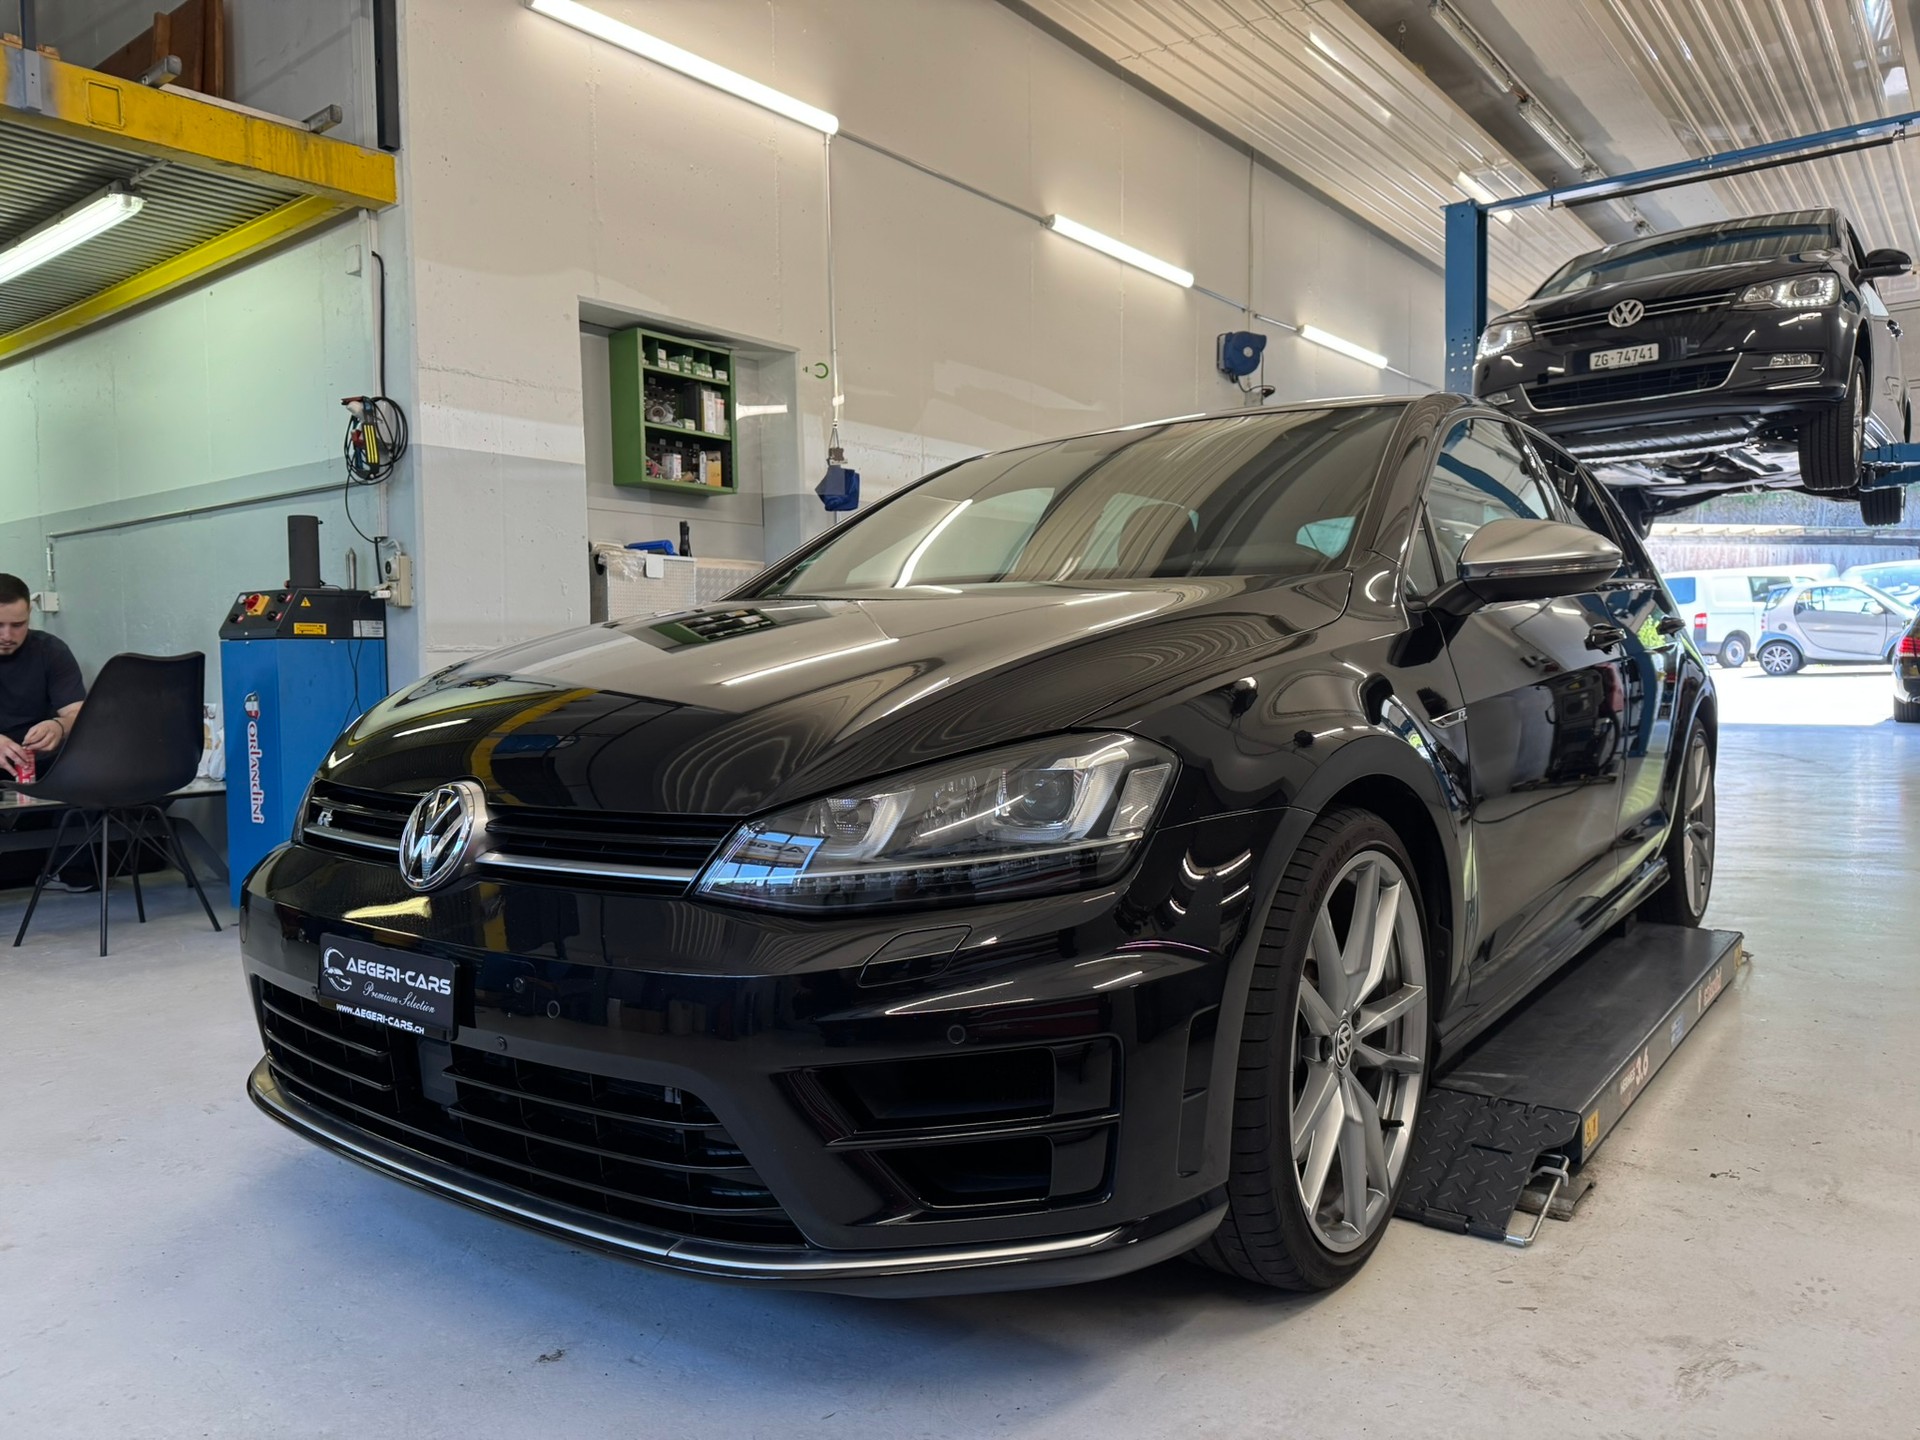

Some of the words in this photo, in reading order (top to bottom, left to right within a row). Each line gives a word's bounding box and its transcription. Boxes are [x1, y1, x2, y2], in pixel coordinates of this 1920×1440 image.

[346, 957, 451, 995] AEGERI-CARS
[362, 981, 398, 1004] Premium
[398, 992, 435, 1014] Selection
